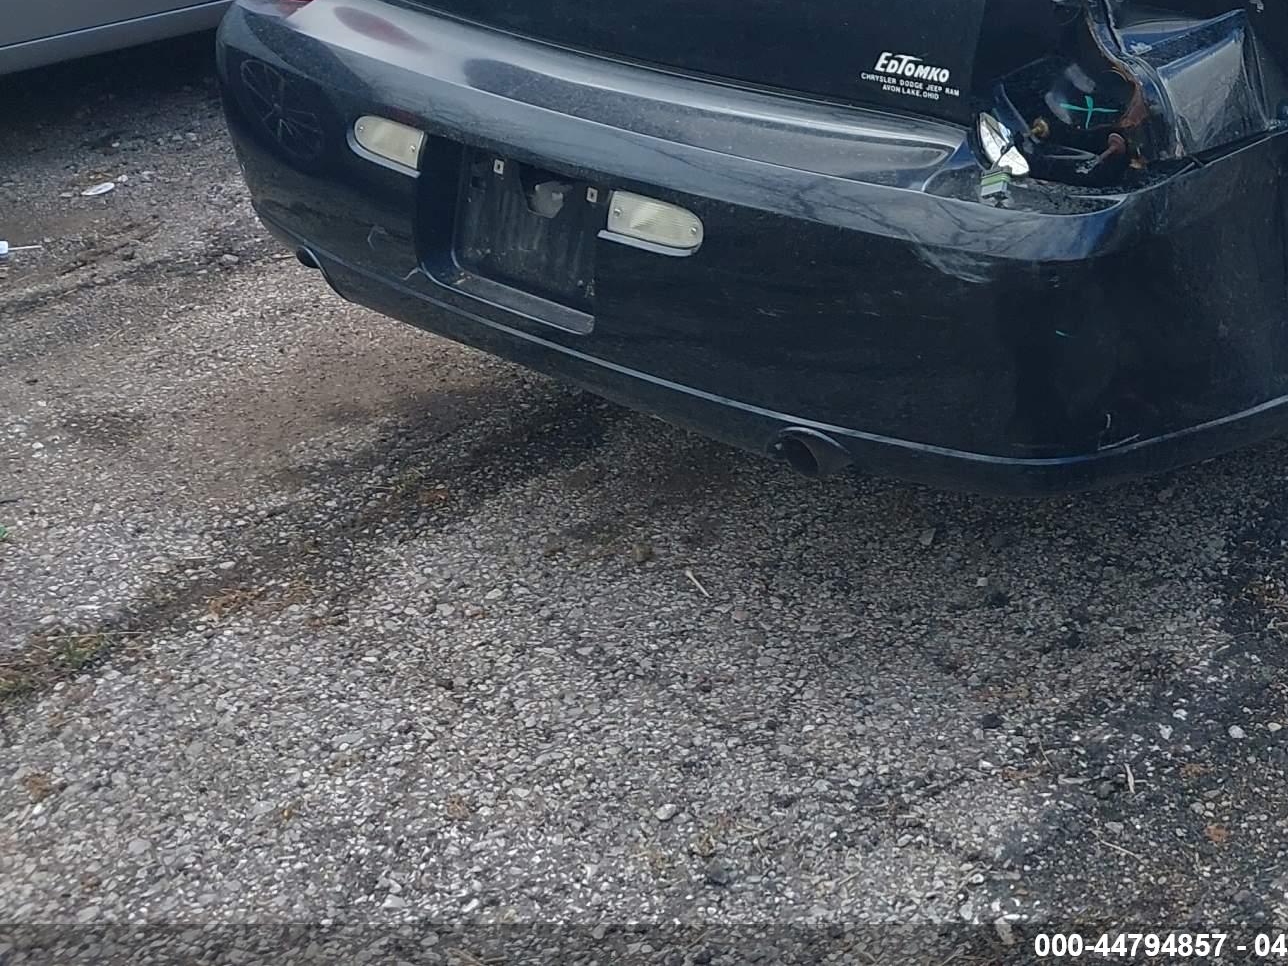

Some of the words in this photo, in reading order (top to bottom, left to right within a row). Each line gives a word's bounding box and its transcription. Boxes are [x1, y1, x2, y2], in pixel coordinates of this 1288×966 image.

[861, 72, 897, 84] CHRYSLER
[899, 79, 924, 90] DODGE
[925, 84, 943, 93] JEEP
[944, 87, 960, 97] RAM
[882, 84, 901, 93] AVON
